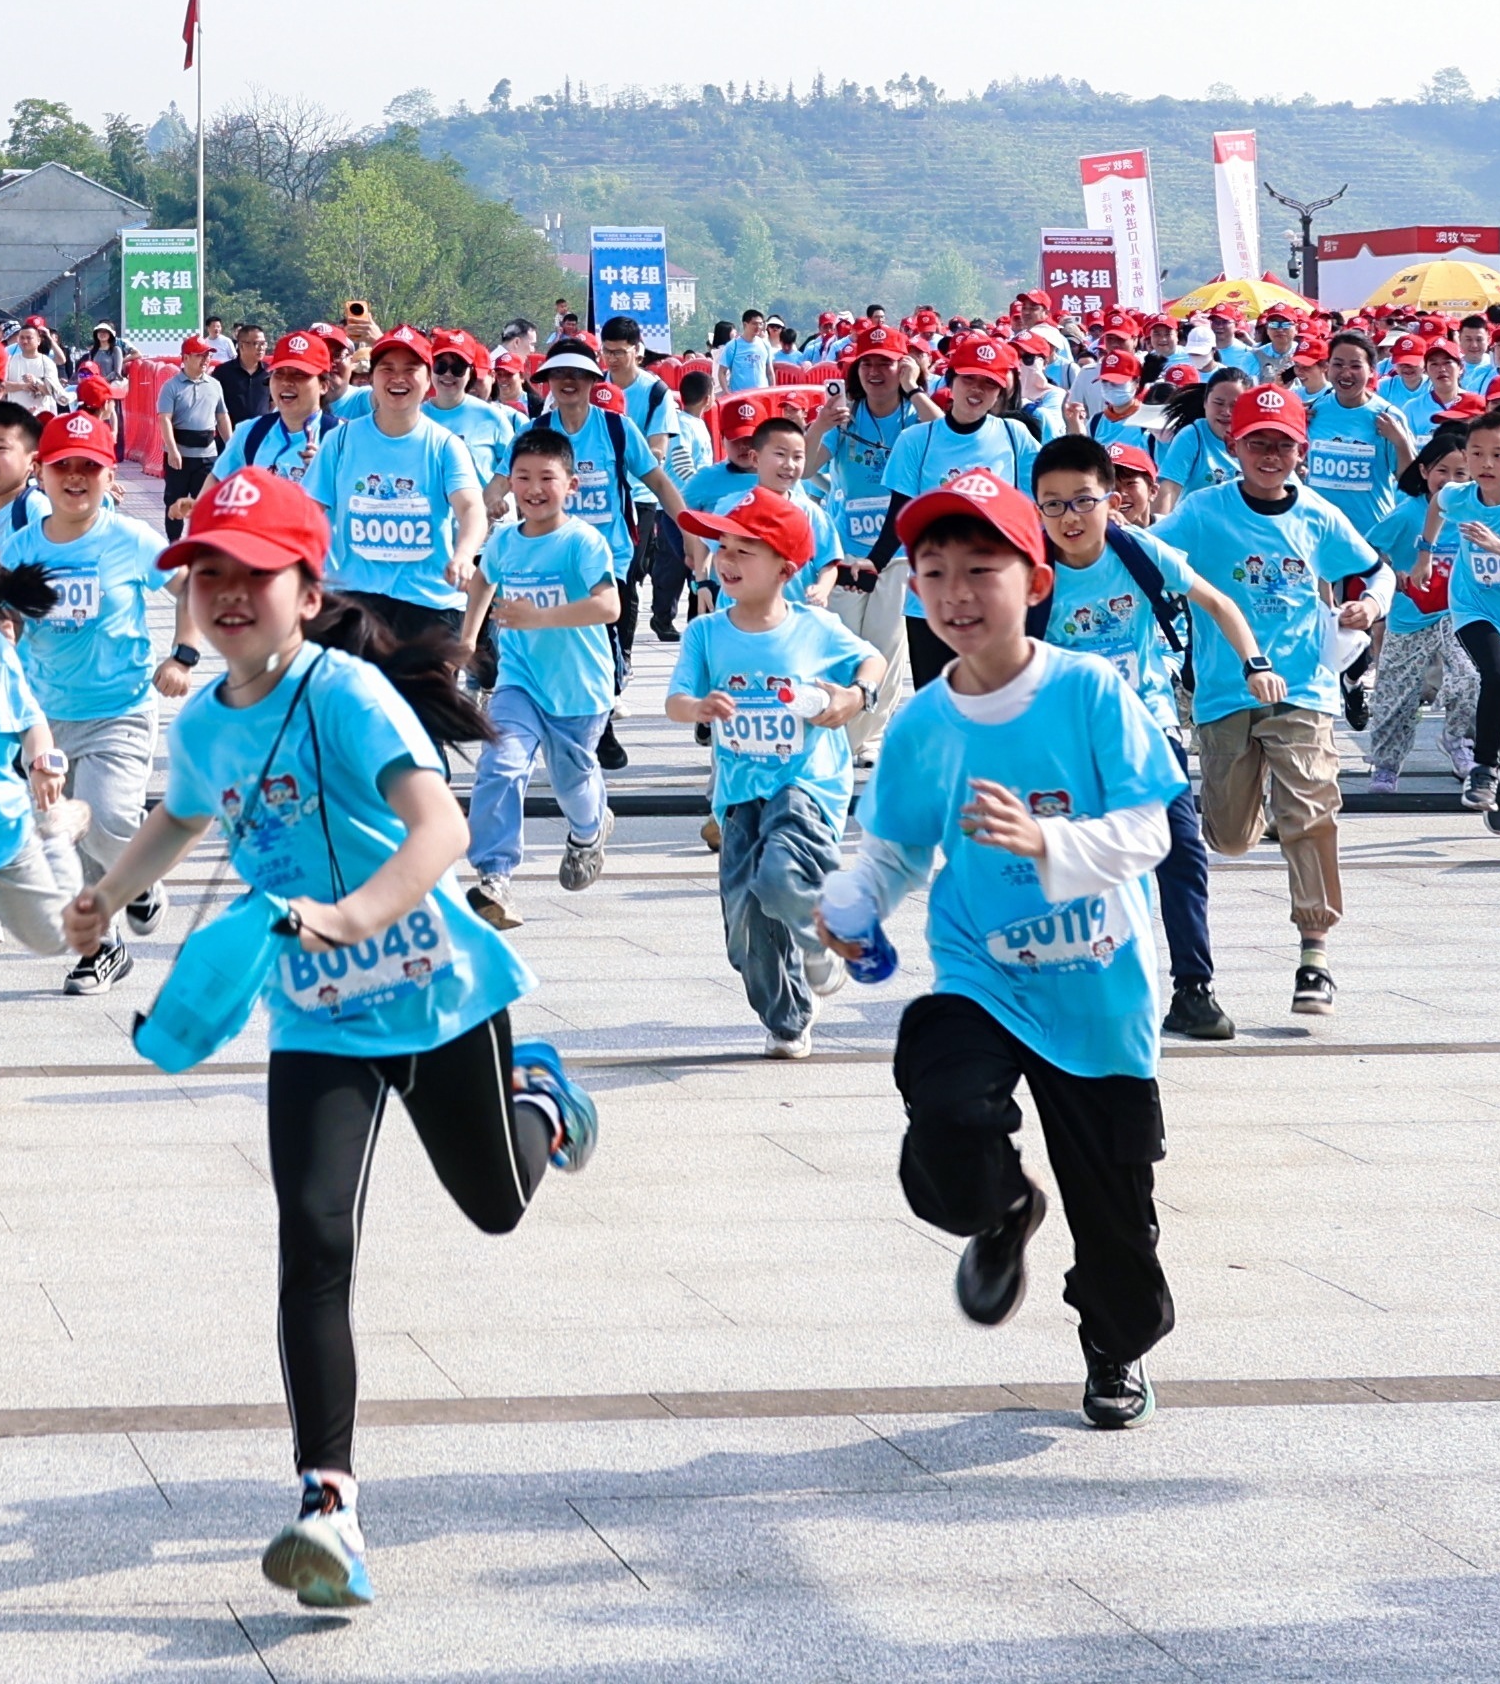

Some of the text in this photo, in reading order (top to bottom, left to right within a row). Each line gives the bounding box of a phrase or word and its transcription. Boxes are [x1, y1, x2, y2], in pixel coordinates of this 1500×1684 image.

[131, 270, 193, 289] 大将组
[600, 265, 661, 284] 中将组
[1050, 269, 1111, 288] 少将组
[141, 296, 182, 315] 检录
[610, 291, 651, 310] 检录
[1062, 294, 1102, 314] 检录
[1313, 456, 1371, 479] B0053
[564, 490, 607, 511] 0143
[350, 518, 431, 545] B0002
[850, 515, 884, 537] B00
[57, 582, 93, 606] 001
[722, 714, 796, 741] B0130
[287, 909, 440, 993] B0048
